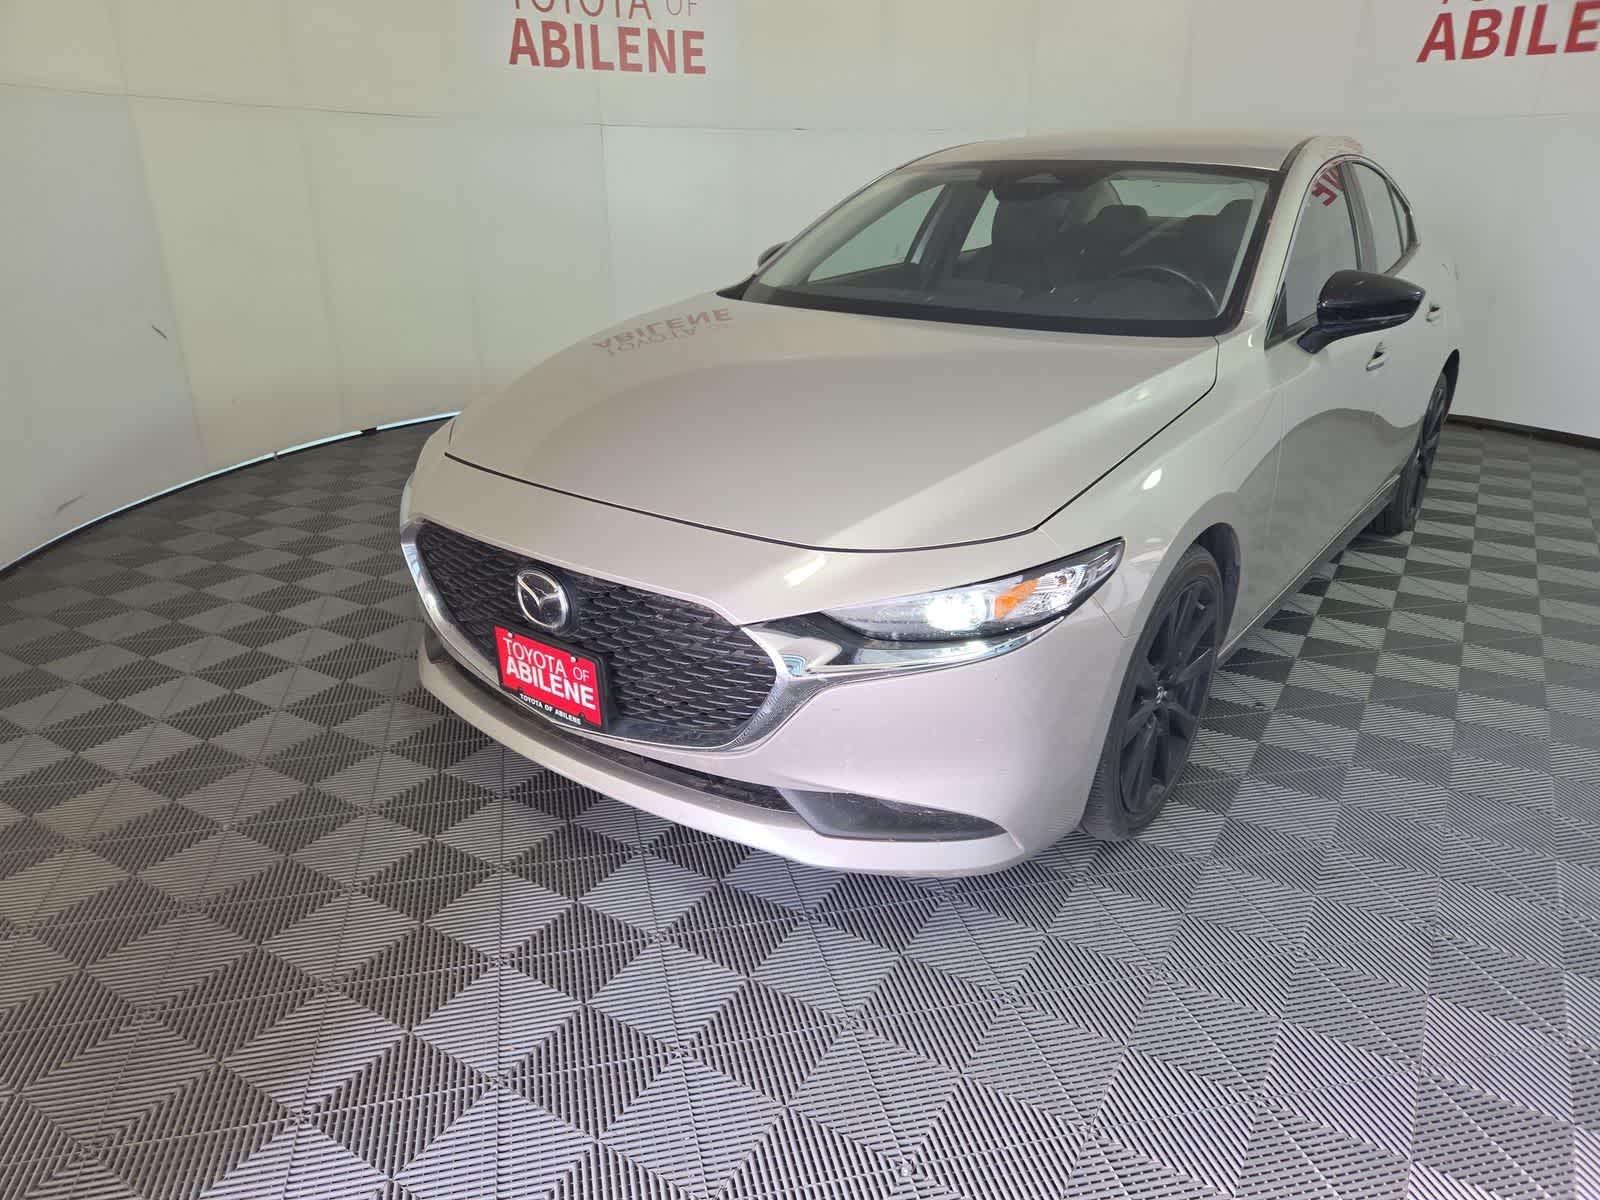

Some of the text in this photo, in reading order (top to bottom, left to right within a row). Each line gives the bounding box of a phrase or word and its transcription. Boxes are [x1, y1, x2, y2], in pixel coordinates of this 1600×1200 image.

[509, 18, 706, 74] ABILENE
[503, 637, 590, 681] TOYOTA OF
[506, 656, 596, 710] ABILENE
[519, 693, 581, 725] TOYOTA OF ABILENE
